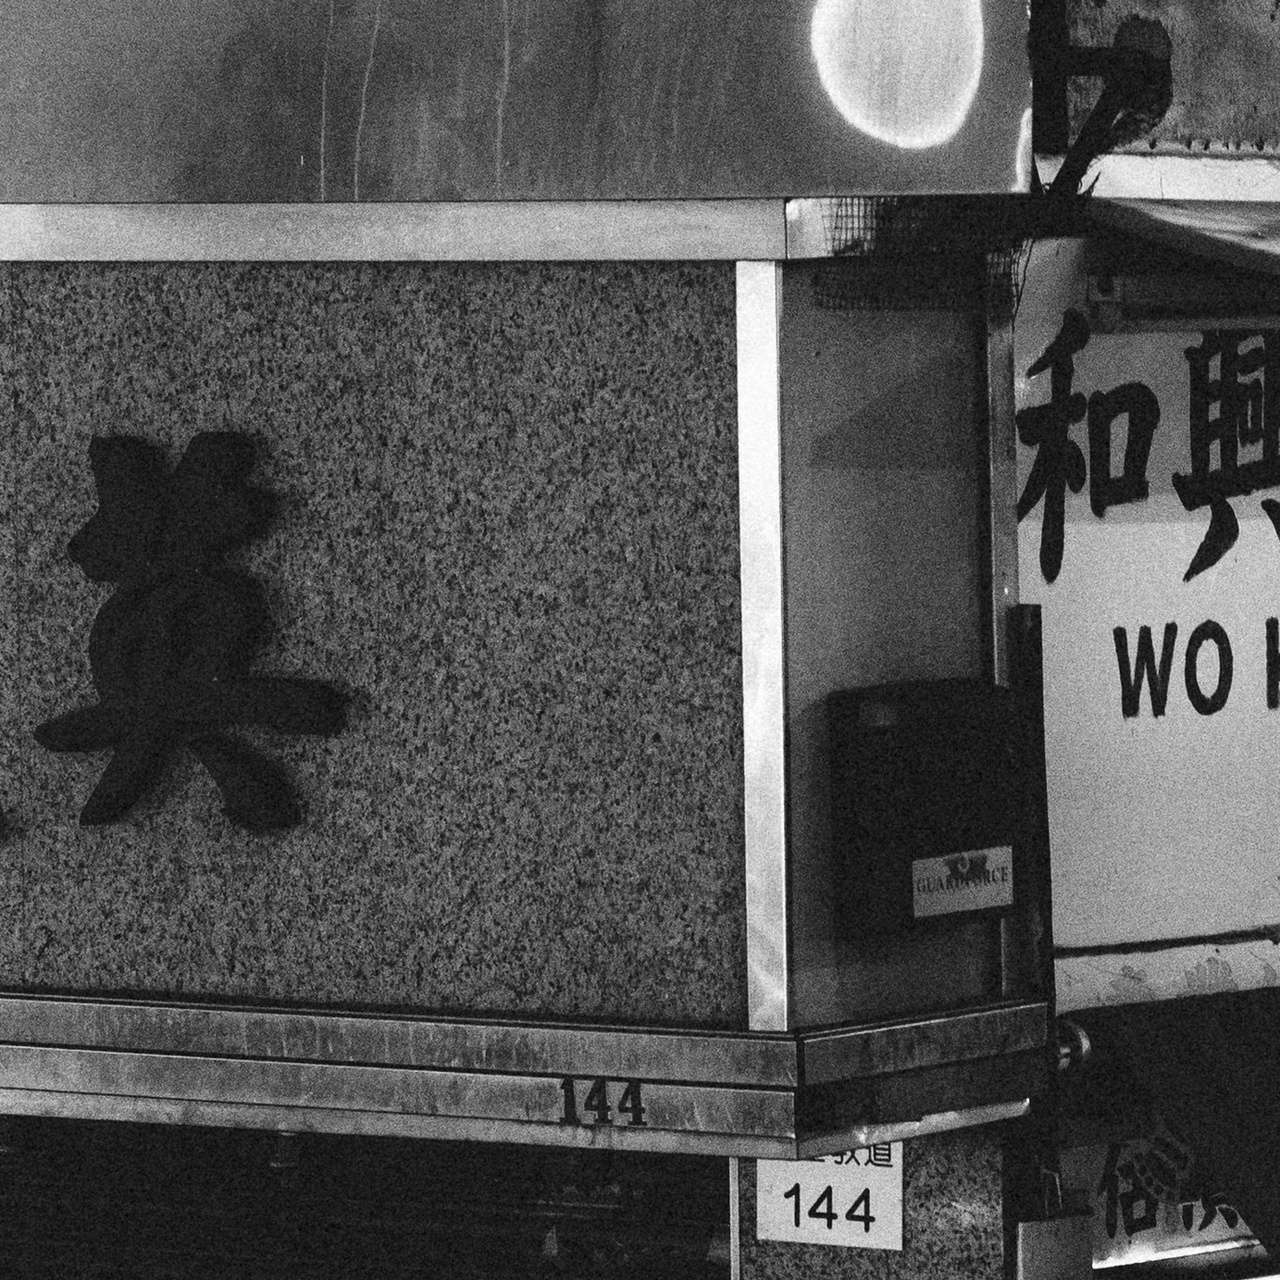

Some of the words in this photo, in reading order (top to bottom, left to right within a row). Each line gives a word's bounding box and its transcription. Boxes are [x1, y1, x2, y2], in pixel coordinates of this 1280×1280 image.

[1112, 619, 1235, 719] WO
[558, 1077, 647, 1126] 144
[783, 1182, 876, 1234] 144
